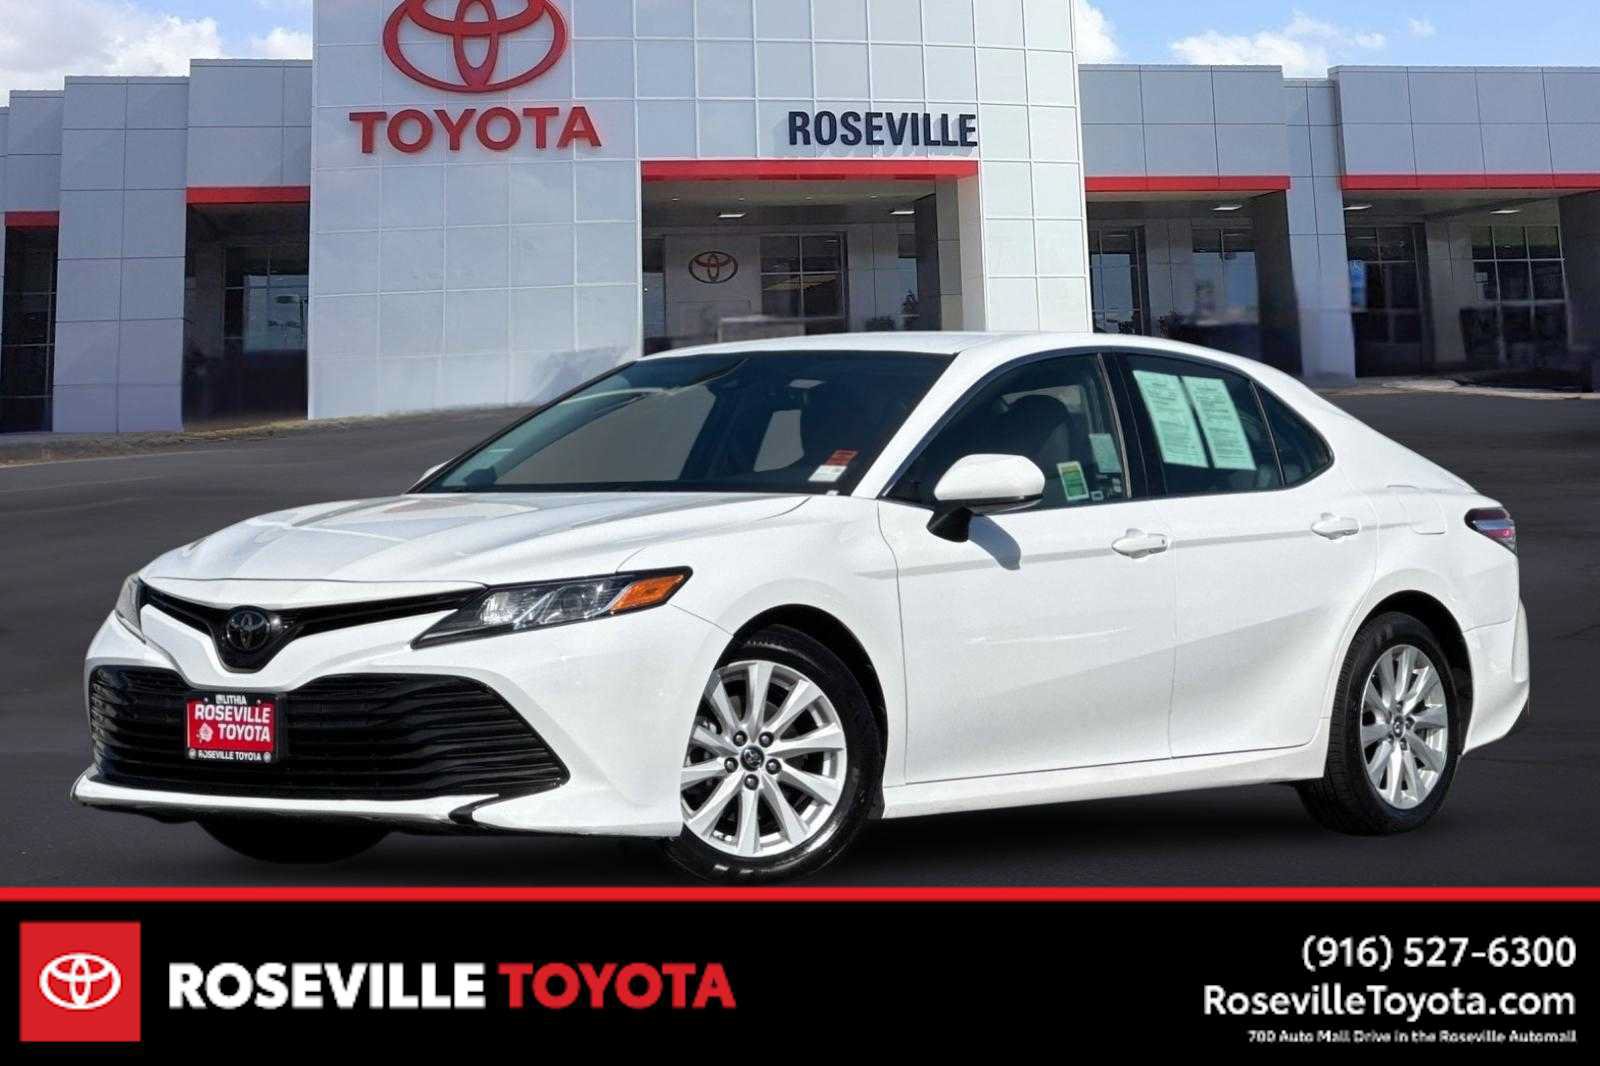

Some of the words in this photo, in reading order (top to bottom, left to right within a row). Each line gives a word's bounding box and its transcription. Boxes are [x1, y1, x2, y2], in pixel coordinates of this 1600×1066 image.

[349, 106, 602, 154] TOYOTA
[788, 111, 977, 147] ROSEVILLE
[194, 704, 271, 723] ROSEVILLE
[218, 723, 271, 742] TOYOTA
[198, 750, 234, 760] ROSEVILLE
[235, 751, 262, 761] TOYOTA
